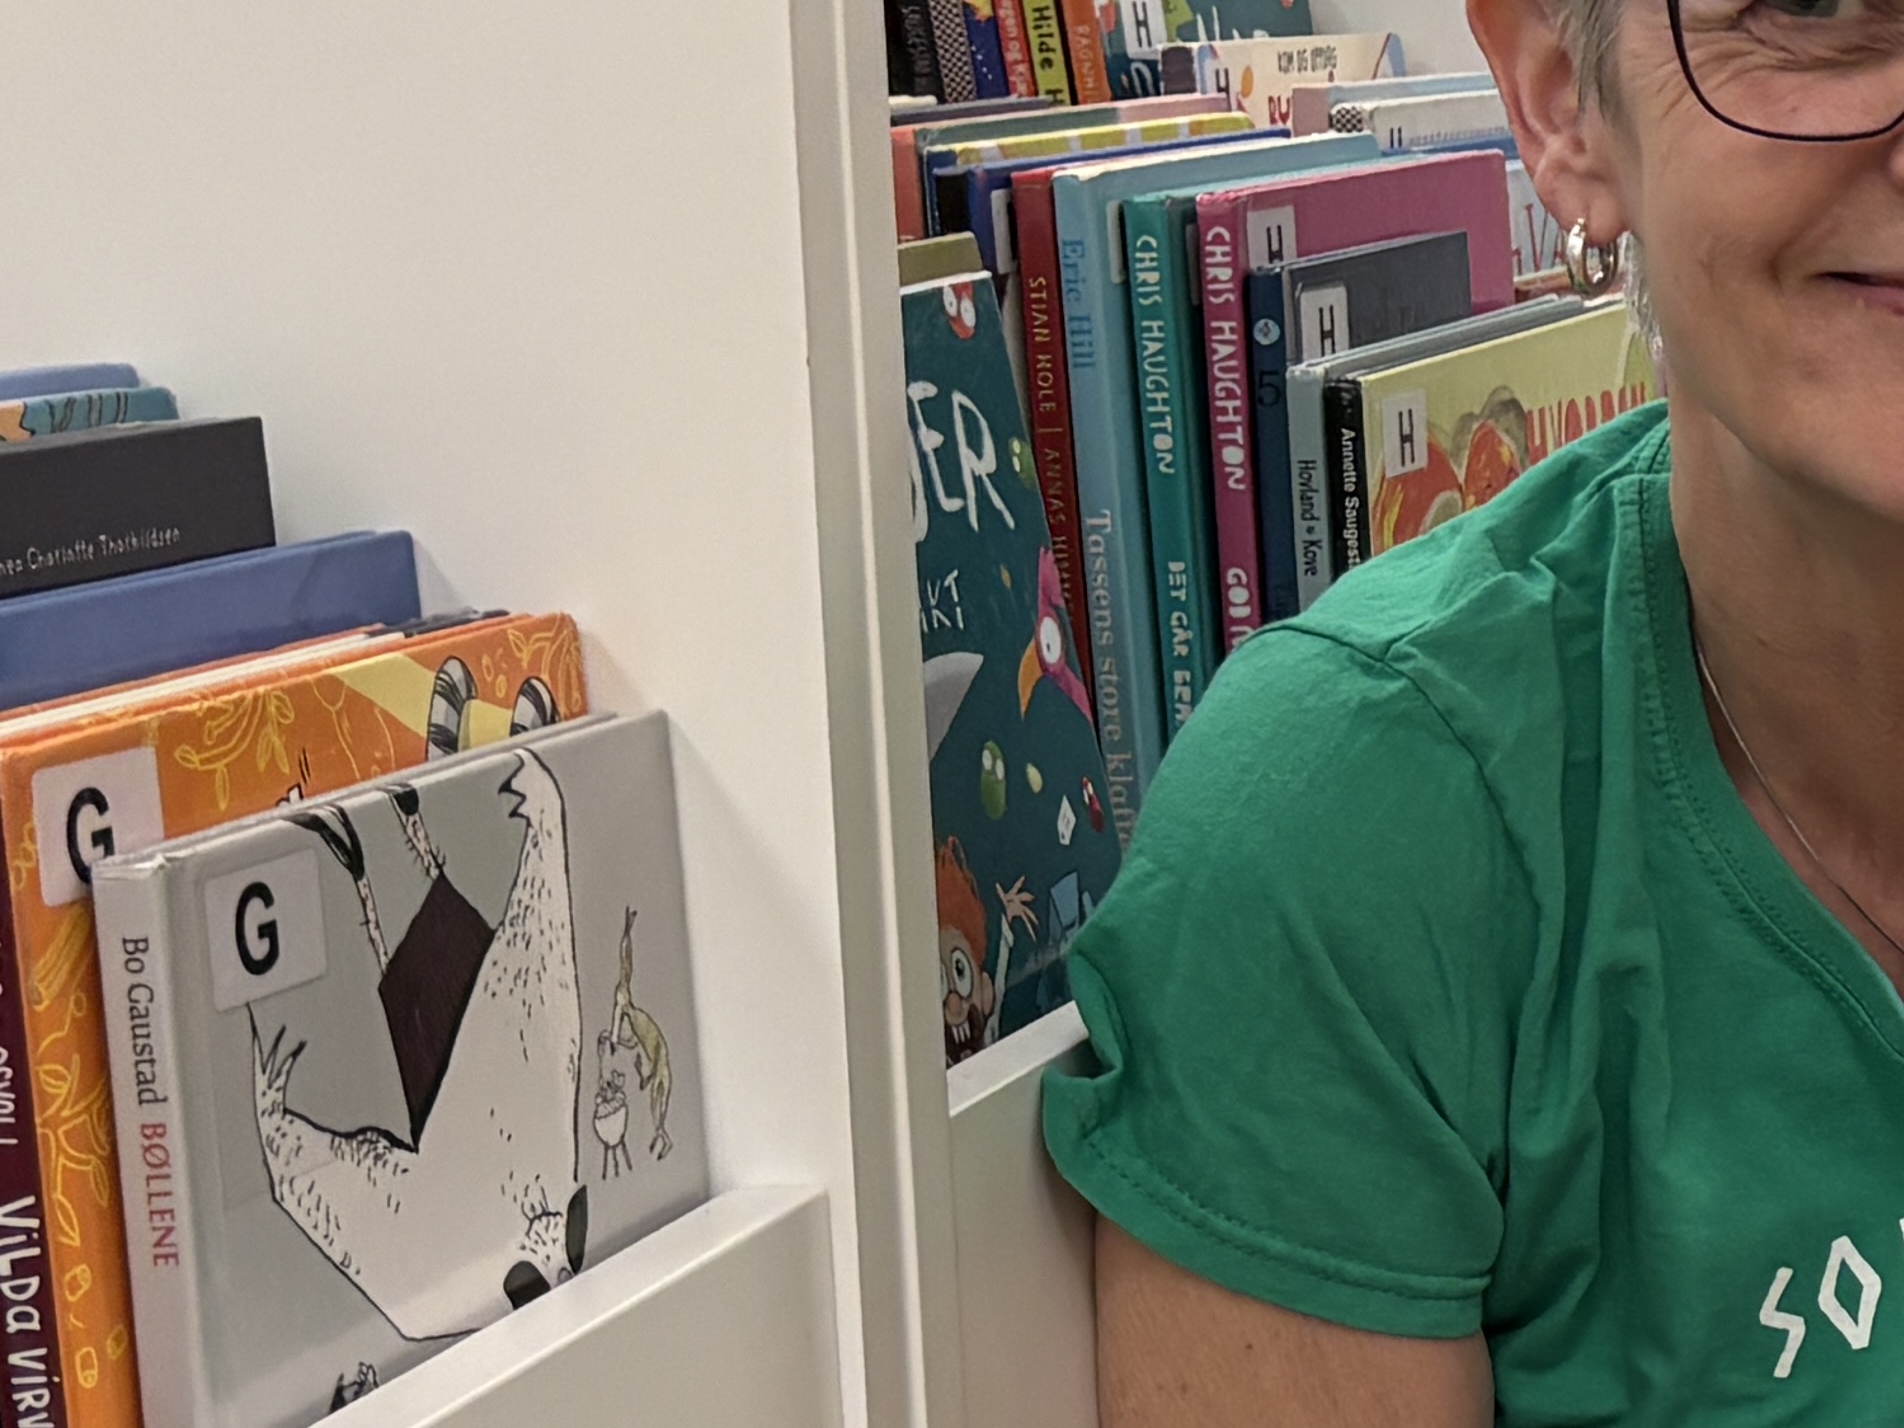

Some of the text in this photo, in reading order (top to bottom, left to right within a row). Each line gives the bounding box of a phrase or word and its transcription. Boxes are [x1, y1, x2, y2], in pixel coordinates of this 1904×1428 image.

[1031, 4, 1057, 71] Hilde
[1128, 0, 1155, 50] H
[1061, 238, 1089, 302] Eric
[1134, 235, 1162, 307] CHRIS
[1204, 225, 1234, 303] CHRIS
[1027, 275, 1052, 343] STIAN
[1066, 309, 1096, 370] Hill
[1034, 353, 1057, 414] HOLE
[1142, 317, 1177, 476] HAUGHTON
[1208, 311, 1248, 491] HAUGHTON
[1340, 427, 1359, 493] Annette
[1396, 406, 1422, 470] H
[1295, 458, 1321, 578] Hovland Kove
[1086, 509, 1115, 645] Tassens
[1226, 566, 1253, 618] GOD
[1096, 657, 1125, 743] store
[65, 785, 115, 885] G
[234, 881, 281, 976] G
[121, 935, 180, 1268] Bo Gaustad BØLLENE
